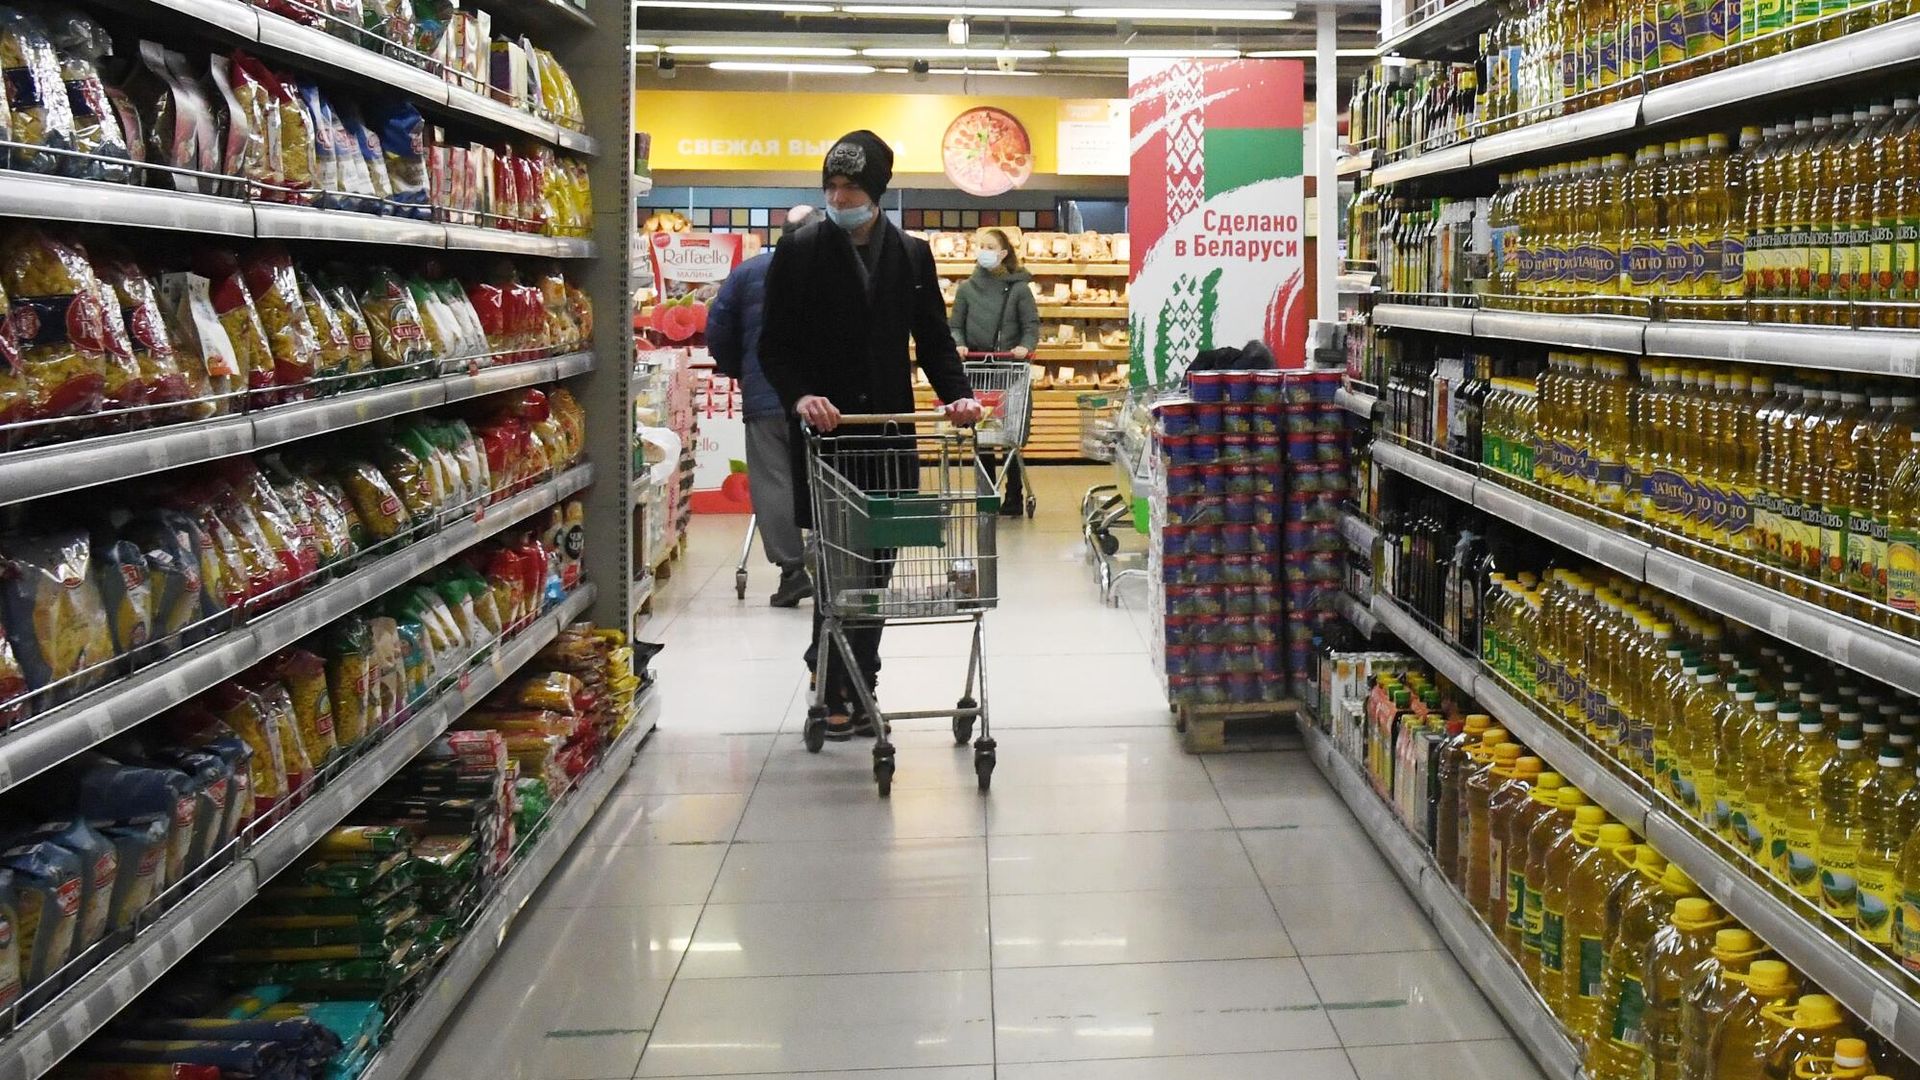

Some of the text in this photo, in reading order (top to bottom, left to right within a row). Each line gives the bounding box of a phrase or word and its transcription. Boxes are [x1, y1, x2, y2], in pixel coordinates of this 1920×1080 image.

[678, 139, 780, 156] СВЕЖАЯ
[1203, 210, 1297, 235] Сделано
[663, 249, 729, 265] Raffaello
[1175, 234, 1297, 261] в Беларуси
